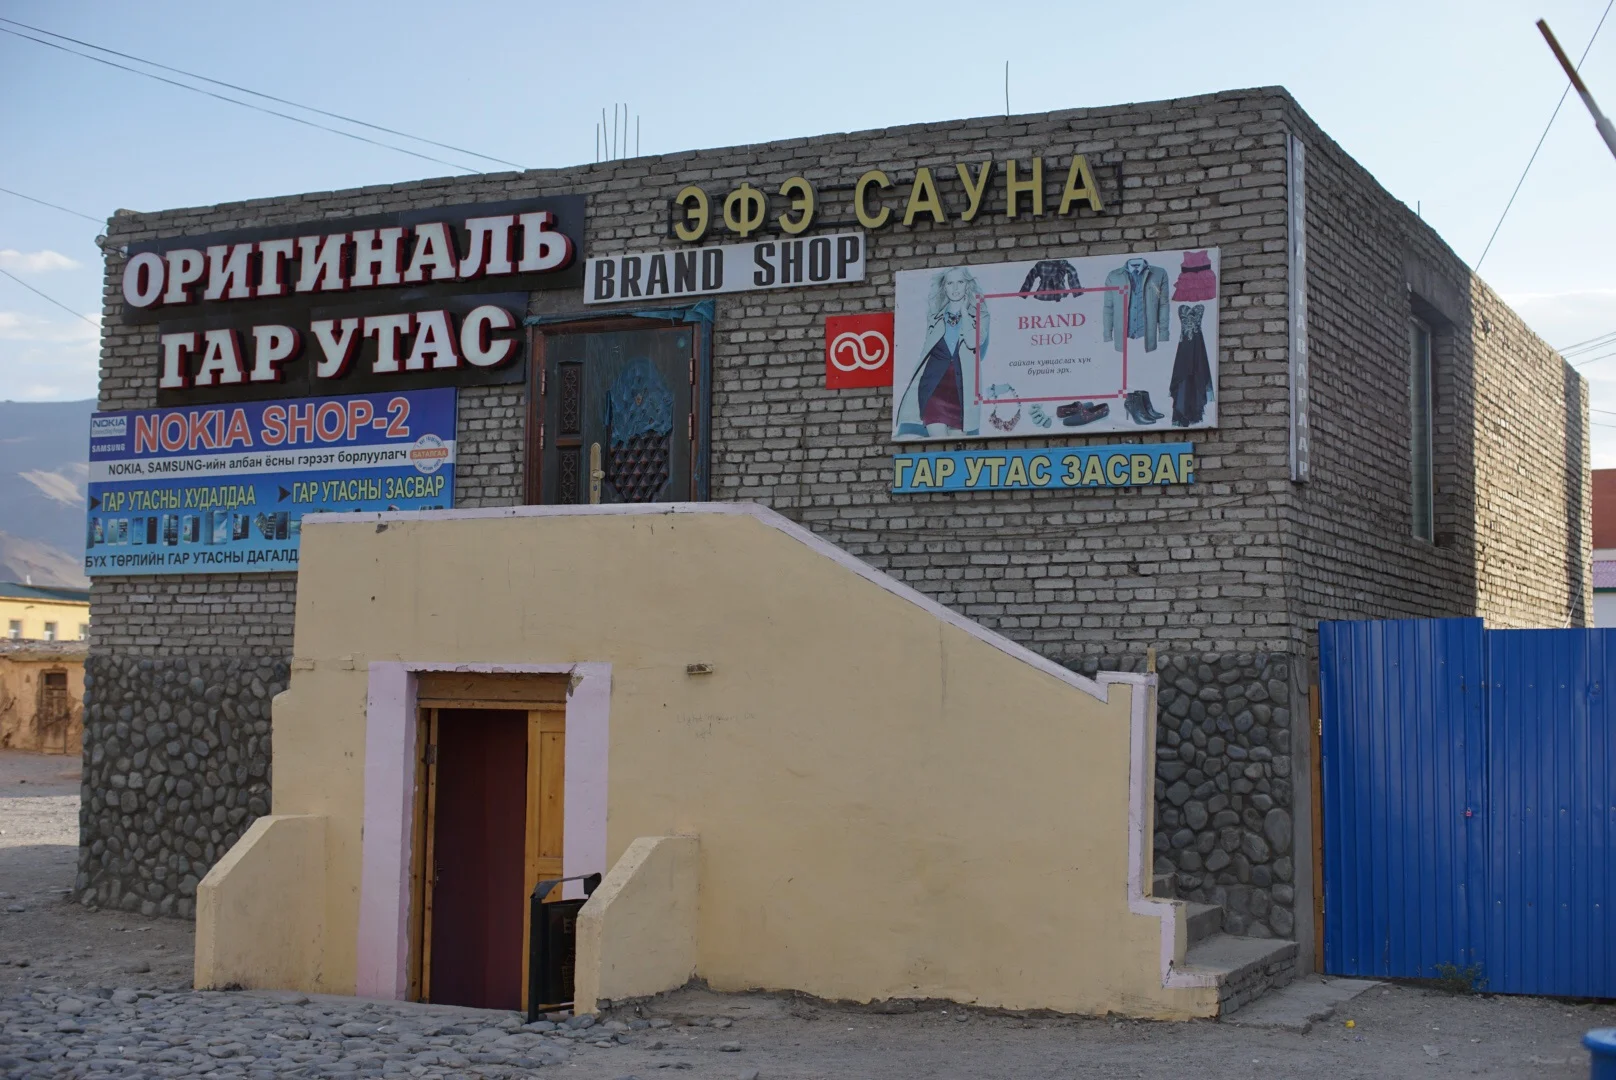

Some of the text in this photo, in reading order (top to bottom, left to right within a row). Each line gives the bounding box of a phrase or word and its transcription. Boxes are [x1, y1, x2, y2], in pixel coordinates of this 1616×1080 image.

[675, 154, 1102, 242] ЭФЭ САУНА
[122, 211, 571, 308] ОРИГИНАЛЬ
[594, 235, 860, 300] BRAND SHOP
[1018, 312, 1086, 330] BRAND
[159, 305, 518, 389] ГАР УТАС
[1031, 332, 1073, 346] SHOP
[1009, 359, 1035, 367] сайхан
[92, 418, 126, 428] NOKIA
[134, 397, 411, 453] NOKIA SHOP-2
[91, 443, 126, 453] SAMSUNG
[108, 462, 145, 475] NOKIA,
[148, 459, 226, 473] SAMSUNG-ийн
[229, 456, 262, 469] албан
[265, 454, 295, 467] ёсны
[298, 453, 335, 466] гэрээт
[338, 449, 407, 465] борлуулагч
[893, 453, 1194, 488] ГАР УТАС ЗАСВАР
[102, 484, 256, 512] ГАР УТАСНЫ ХУДАЛДАА
[292, 475, 445, 503] ГАР УТАСНЫ ЗАСВАР
[85, 548, 299, 568] БҮХ ТӨРЛИЙН ГАР УТАСНЫ ДАГАЛД
